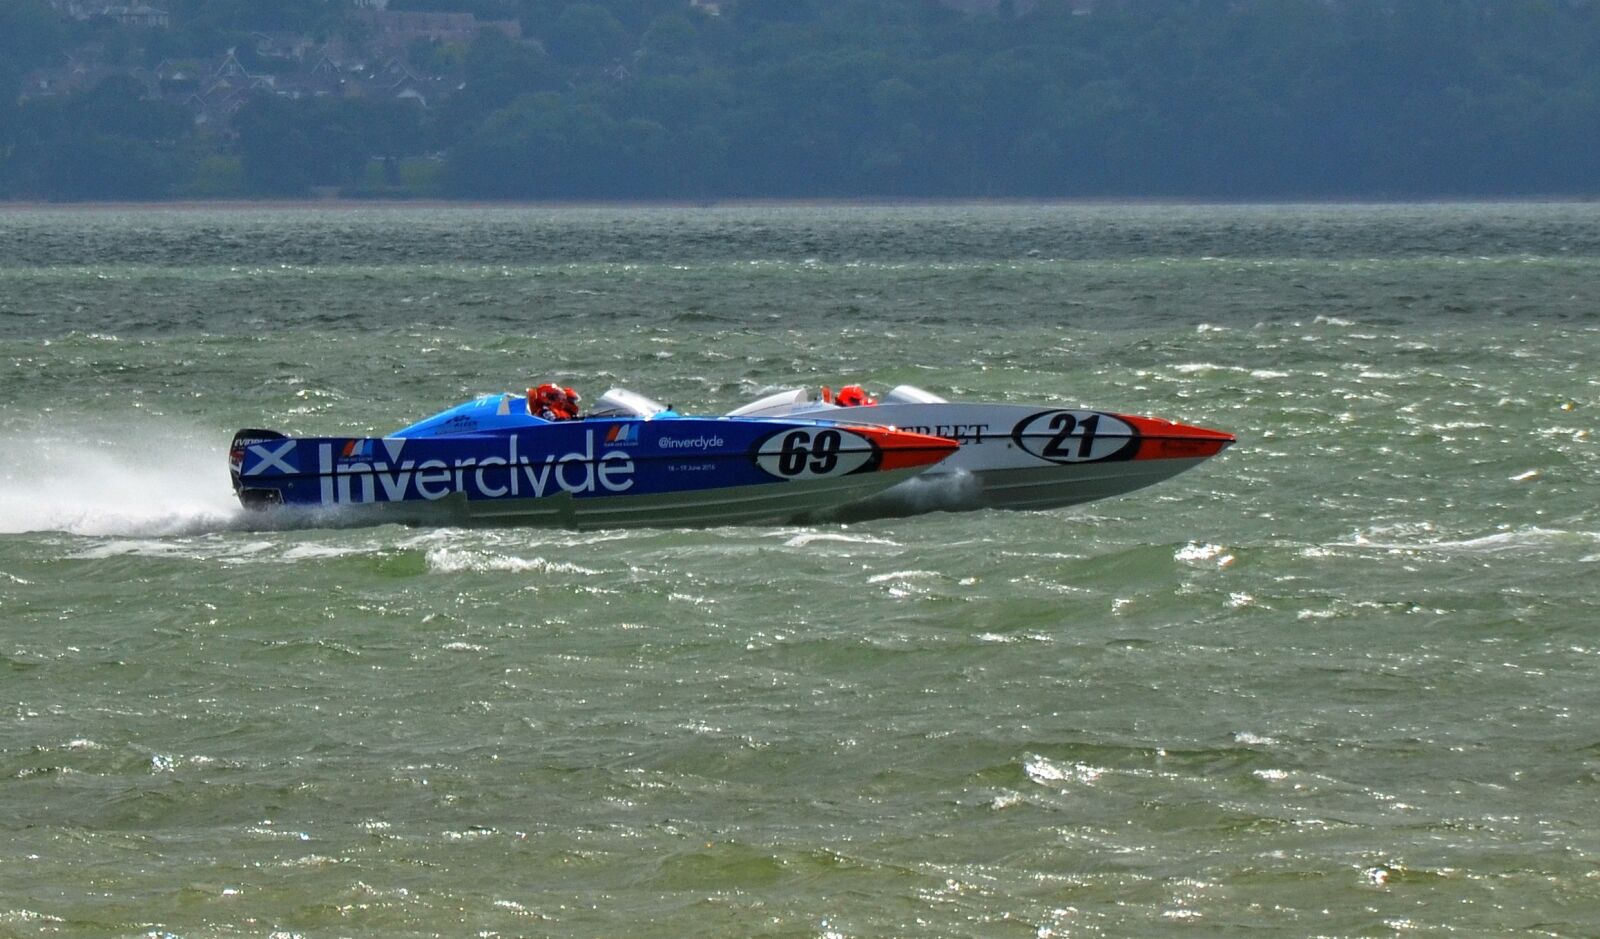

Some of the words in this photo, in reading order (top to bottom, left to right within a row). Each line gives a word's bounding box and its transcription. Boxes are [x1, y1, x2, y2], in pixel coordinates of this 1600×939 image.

[658, 434, 724, 450] @inverclyde
[779, 430, 842, 476] 69
[1042, 414, 1101, 458] 21
[319, 429, 635, 506] Inverclyde
